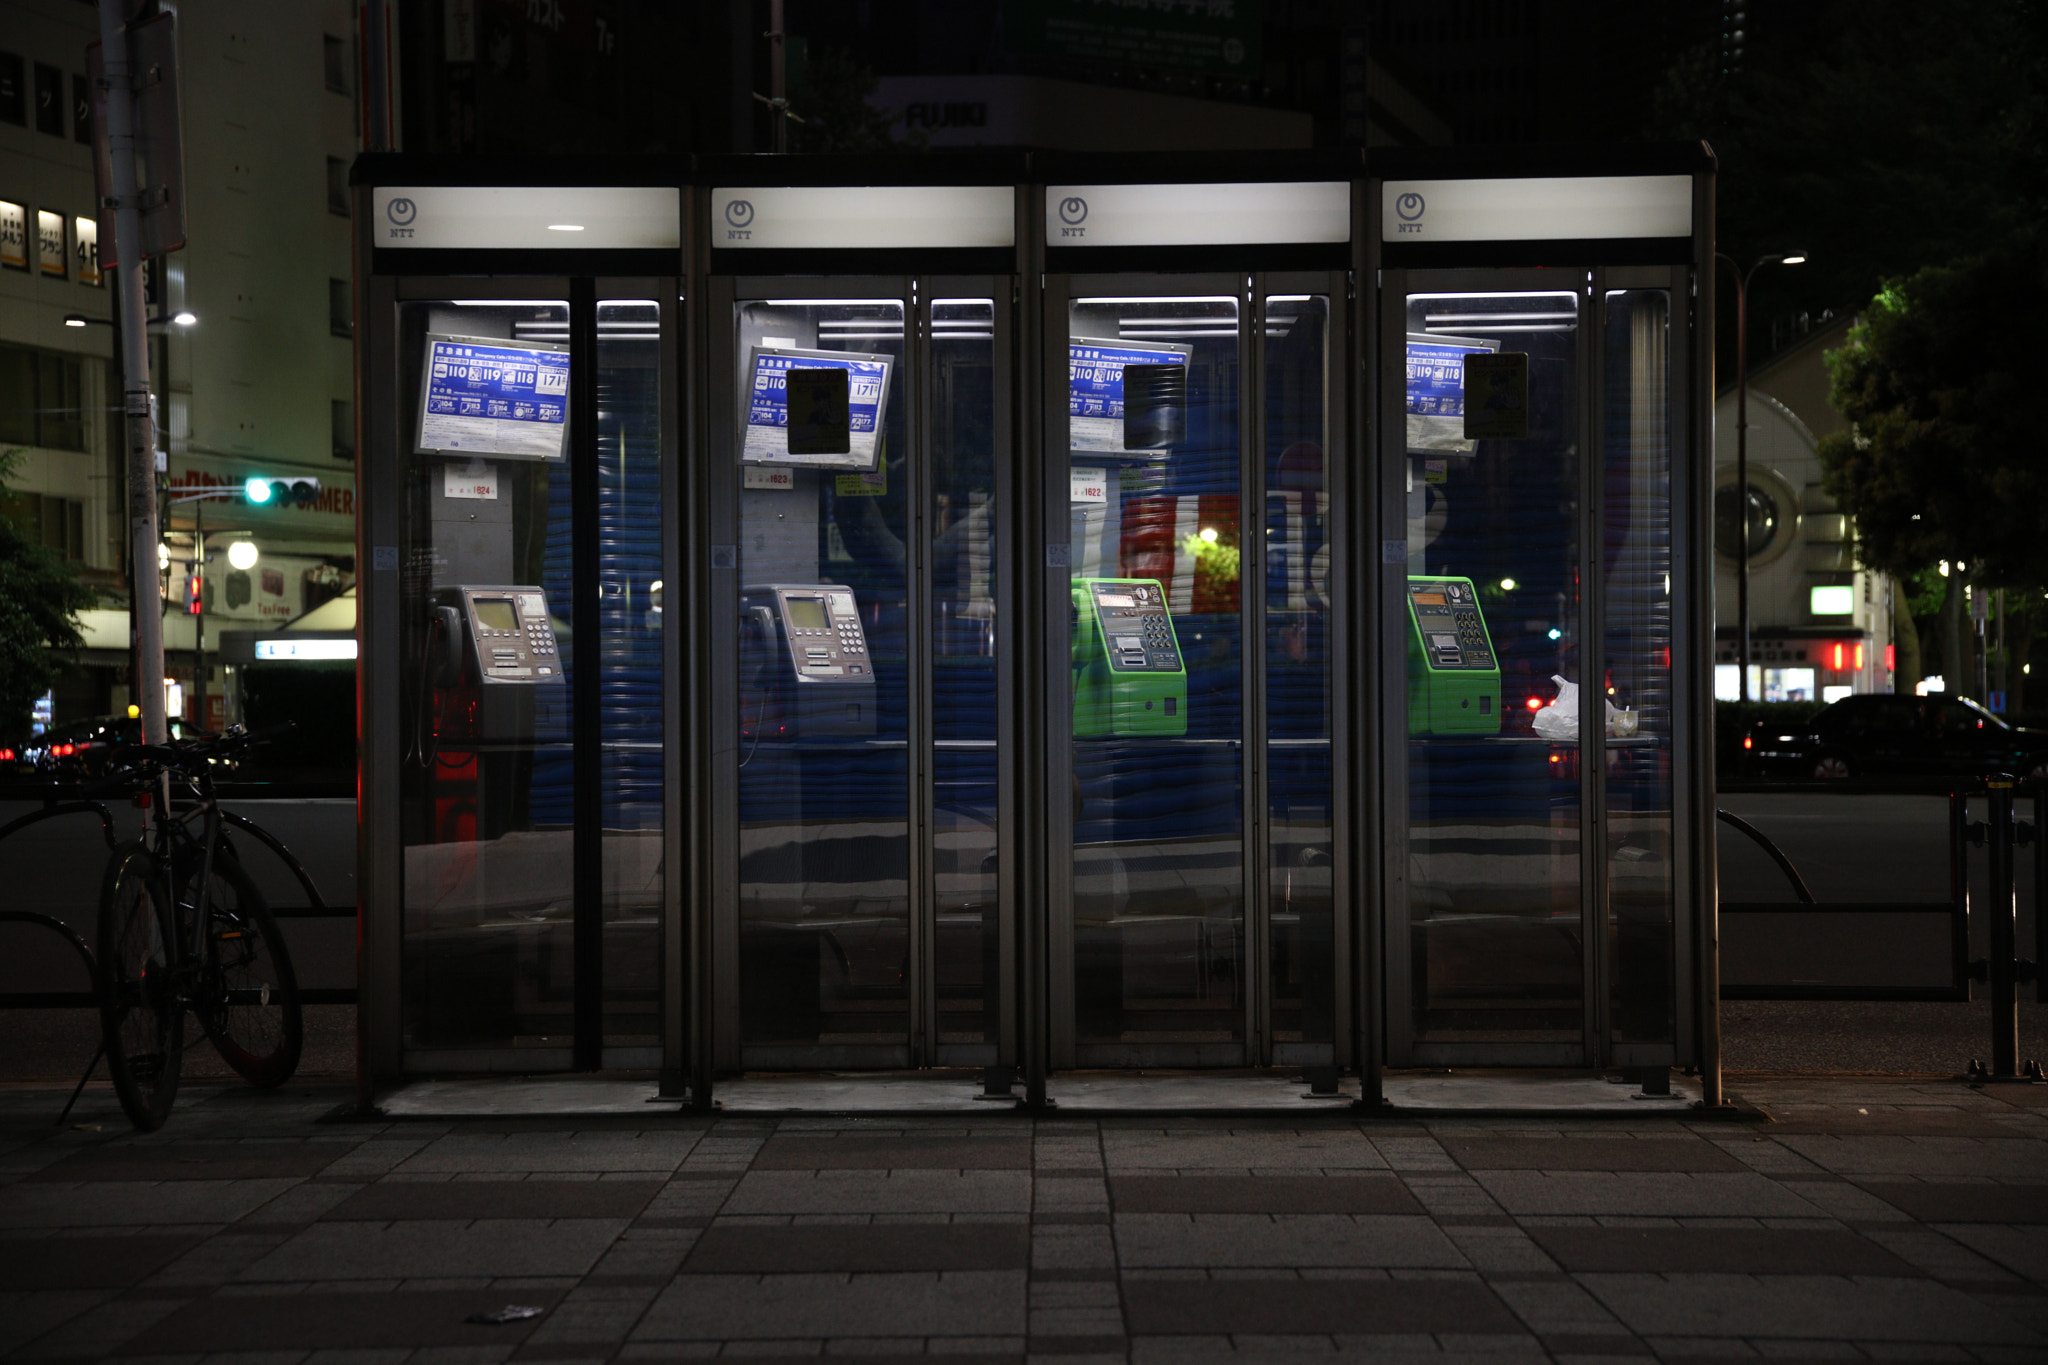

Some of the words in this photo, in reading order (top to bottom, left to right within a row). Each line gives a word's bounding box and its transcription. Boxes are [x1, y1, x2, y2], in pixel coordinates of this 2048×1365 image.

[390, 228, 415, 238] NTT
[1061, 227, 1086, 237] NTT
[1398, 223, 1423, 233] NTT
[727, 230, 752, 239] NTT
[449, 365, 467, 378] 110
[483, 369, 501, 381] 119
[1076, 368, 1092, 380] 110
[1106, 370, 1123, 382] 119
[1416, 366, 1432, 378] 119
[1444, 368, 1460, 379] 118
[517, 372, 535, 384] 118
[543, 374, 561, 386] 171
[769, 378, 787, 390] 110
[857, 383, 874, 396] 171
[770, 475, 788, 484] 1623
[1085, 487, 1102, 497] 1622
